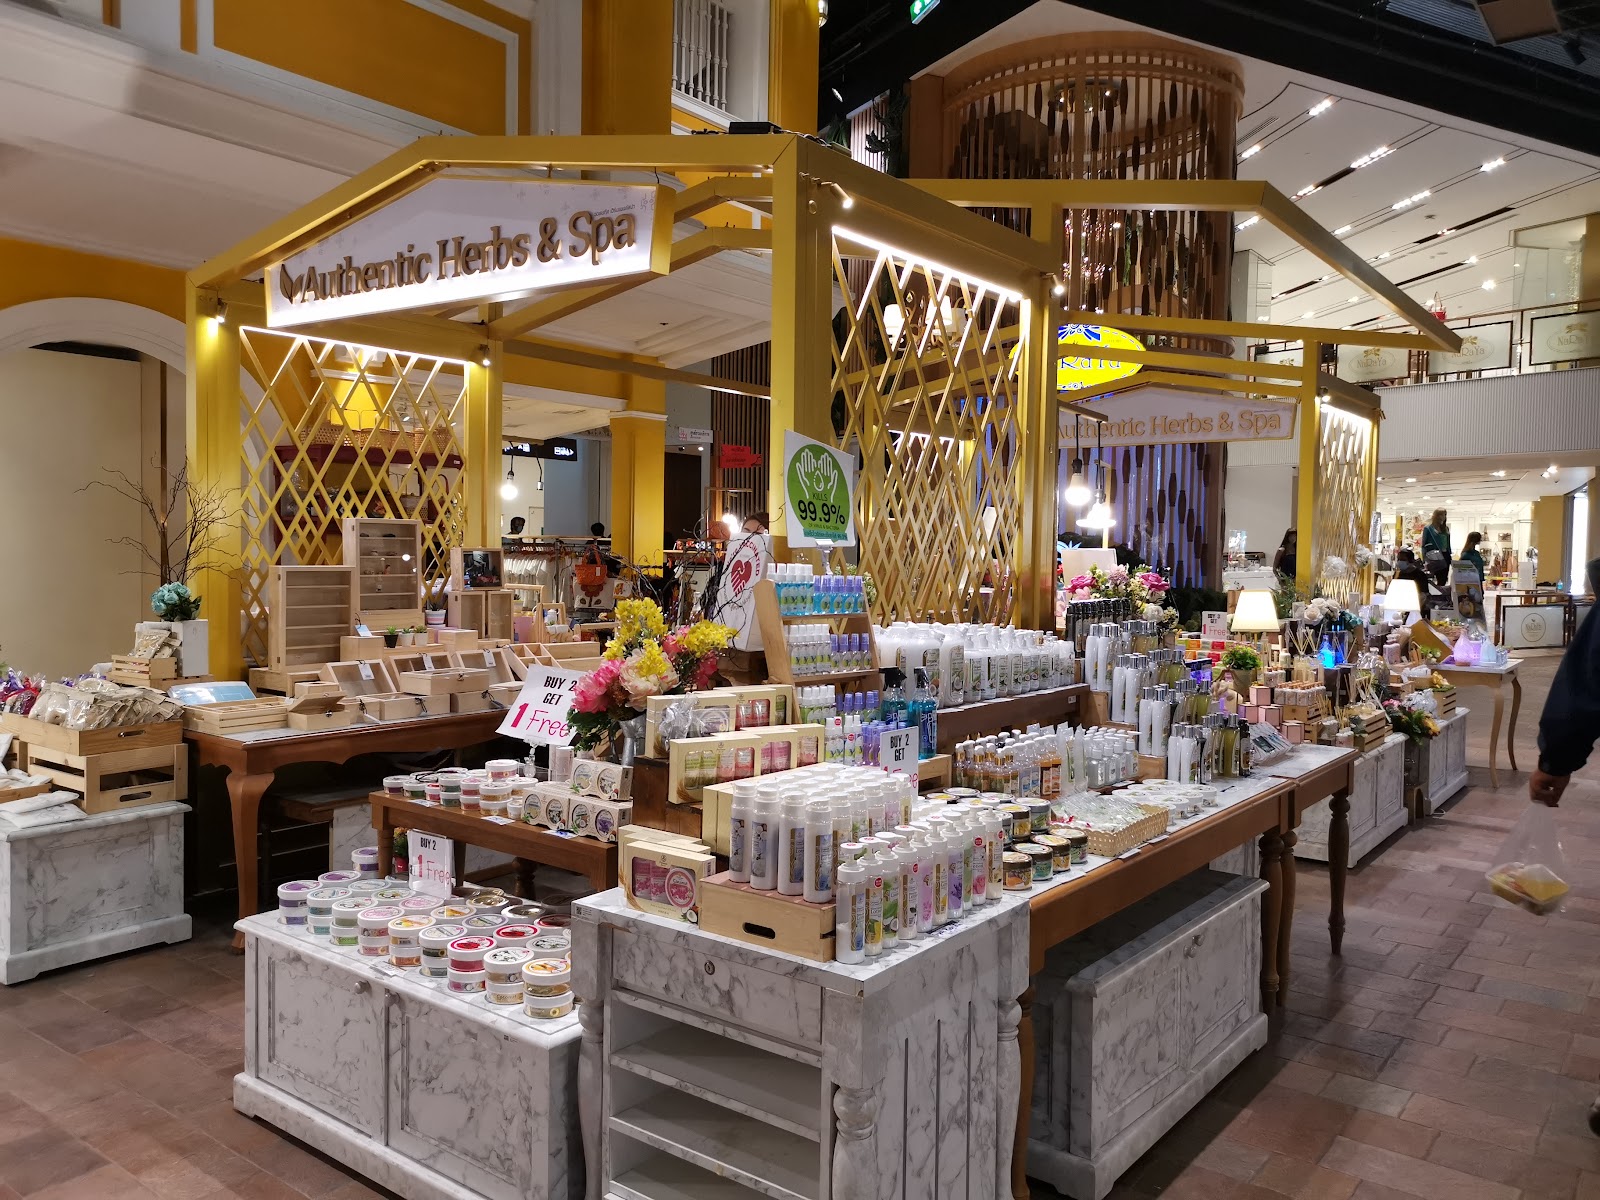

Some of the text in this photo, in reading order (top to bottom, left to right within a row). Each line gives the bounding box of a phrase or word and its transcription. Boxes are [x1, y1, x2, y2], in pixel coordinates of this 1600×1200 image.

[300, 210, 636, 304] Authentic Herbs & Spa
[1152, 411, 1213, 437] Herbs
[1218, 411, 1234, 432] &
[1238, 409, 1281, 436] Spa
[798, 499, 846, 525] 99.9%
[543, 675, 578, 692] BUY 2
[542, 692, 564, 706] GET
[511, 703, 570, 739] 1 Free
[890, 733, 910, 749] BUY 2
[894, 747, 905, 762] GET
[420, 837, 437, 850] BUY 2
[418, 855, 451, 884] 1 Free
